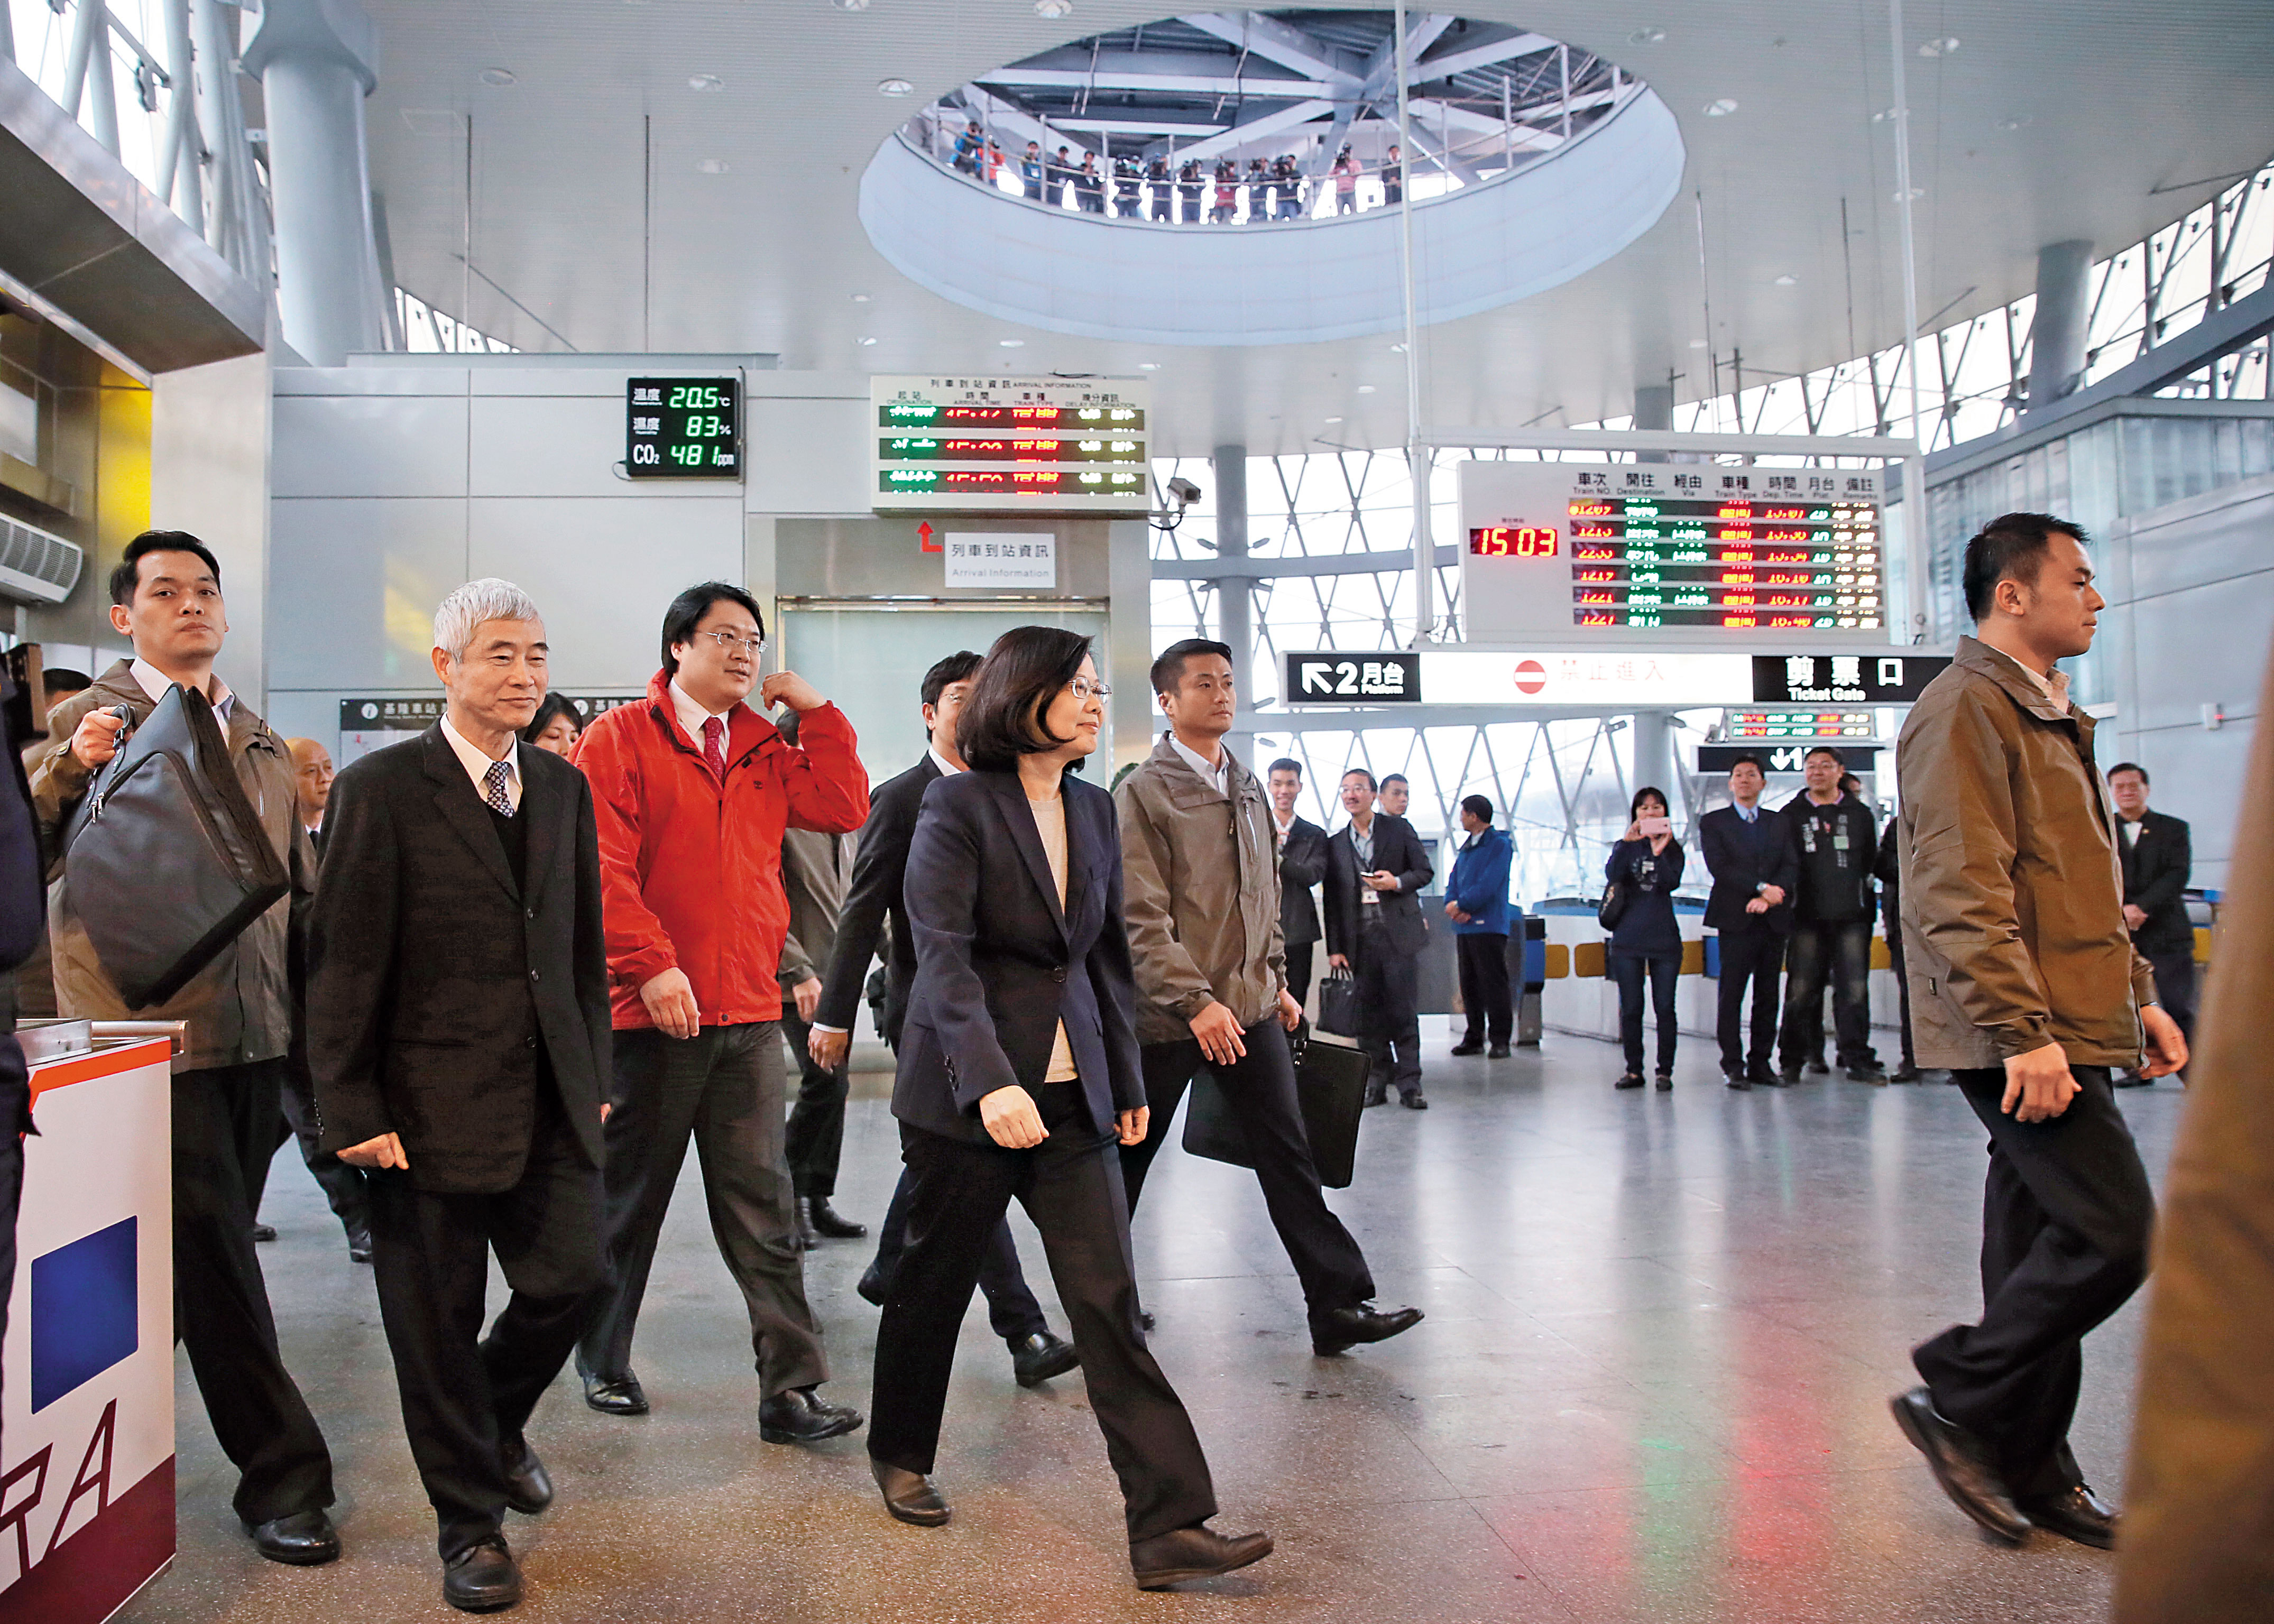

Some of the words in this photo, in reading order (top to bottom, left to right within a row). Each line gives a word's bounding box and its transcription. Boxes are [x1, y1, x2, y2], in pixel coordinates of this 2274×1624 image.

[686, 415, 720, 437] 83
[670, 445, 721, 465] 481
[1578, 473, 1607, 485] 車次
[1810, 477, 1835, 491] 月台
[952, 544, 1048, 558] 列車到站資訊
[953, 568, 986, 577] Arrival
[989, 568, 1049, 577] Information
[1560, 659, 1664, 681] 禁止進入
[1785, 656, 1903, 687] 剪票口
[1335, 661, 1358, 694] 2
[1361, 661, 1405, 685] 月台
[1361, 684, 1404, 694] Platform
[1787, 687, 1831, 701] Ticket
[1831, 687, 1866, 701] Gate
